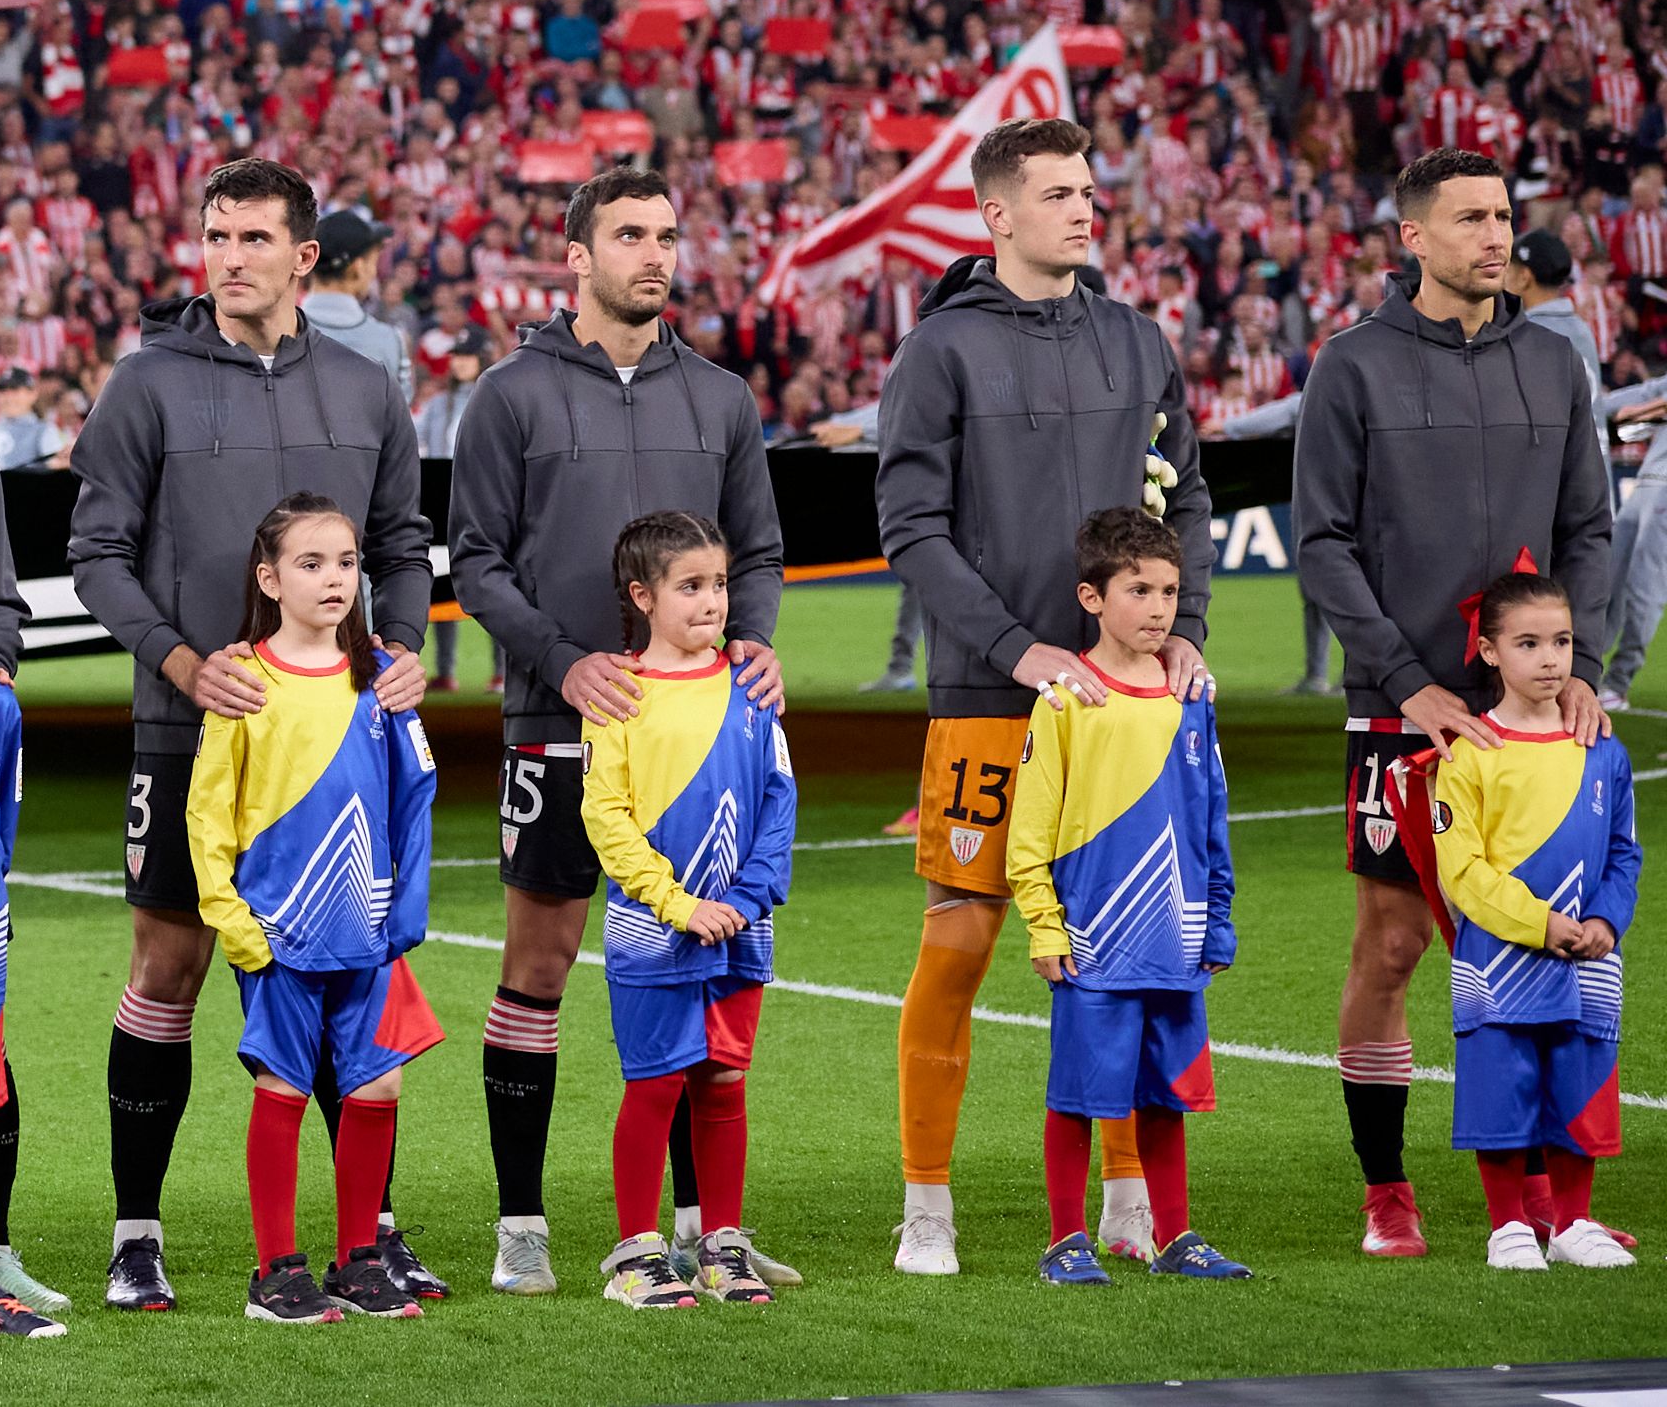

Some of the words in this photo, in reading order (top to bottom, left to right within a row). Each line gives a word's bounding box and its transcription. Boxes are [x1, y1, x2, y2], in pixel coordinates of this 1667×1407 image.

[127, 773, 153, 839] 3
[500, 759, 546, 824] 15
[943, 757, 1012, 827] 13
